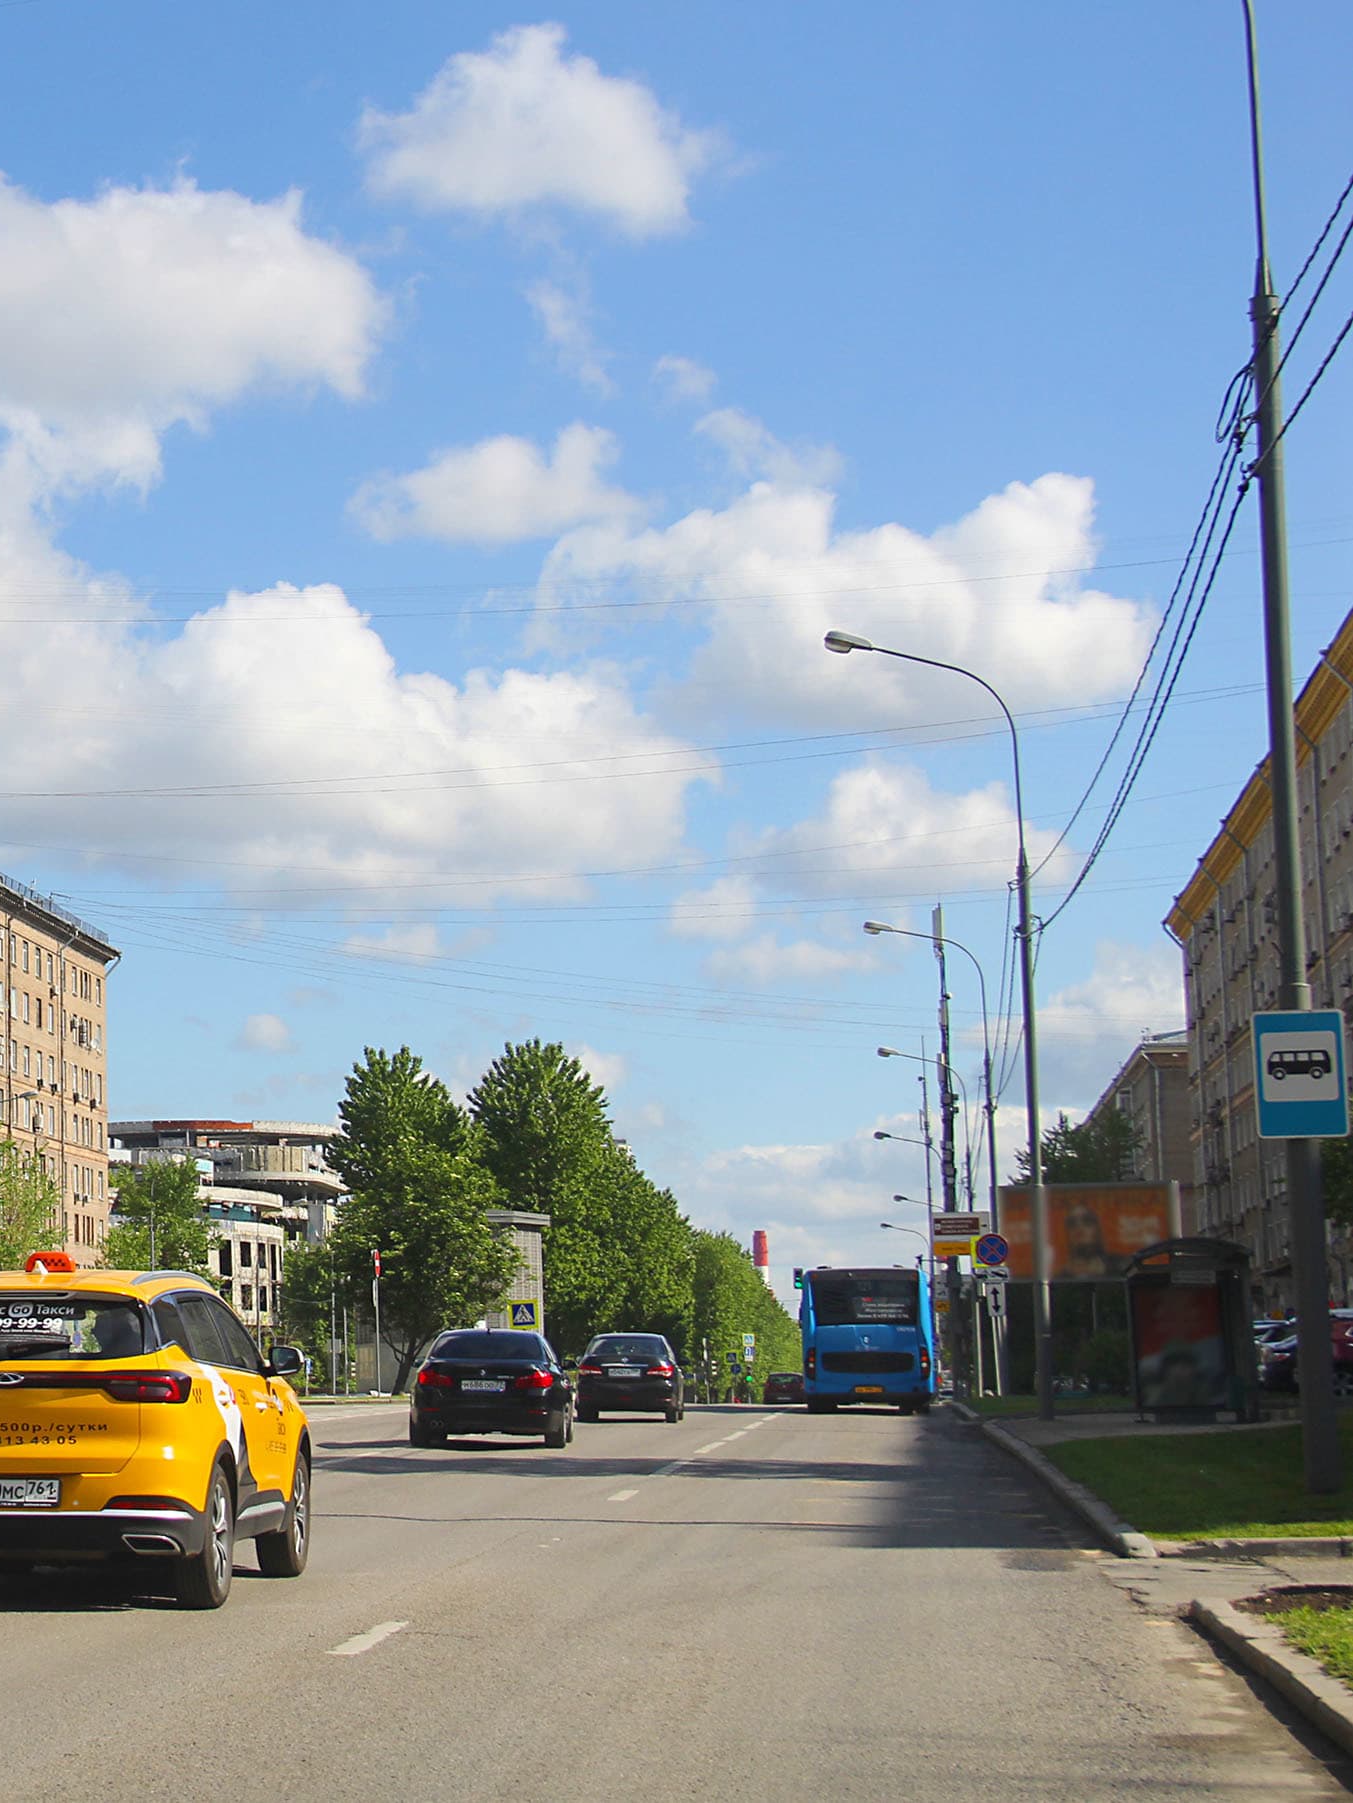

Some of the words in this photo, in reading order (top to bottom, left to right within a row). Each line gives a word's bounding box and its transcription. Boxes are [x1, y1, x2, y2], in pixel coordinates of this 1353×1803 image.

[36, 1303, 75, 1315] Такси
[30, 1435, 50, 1444] 43
[56, 1435, 77, 1444] 05
